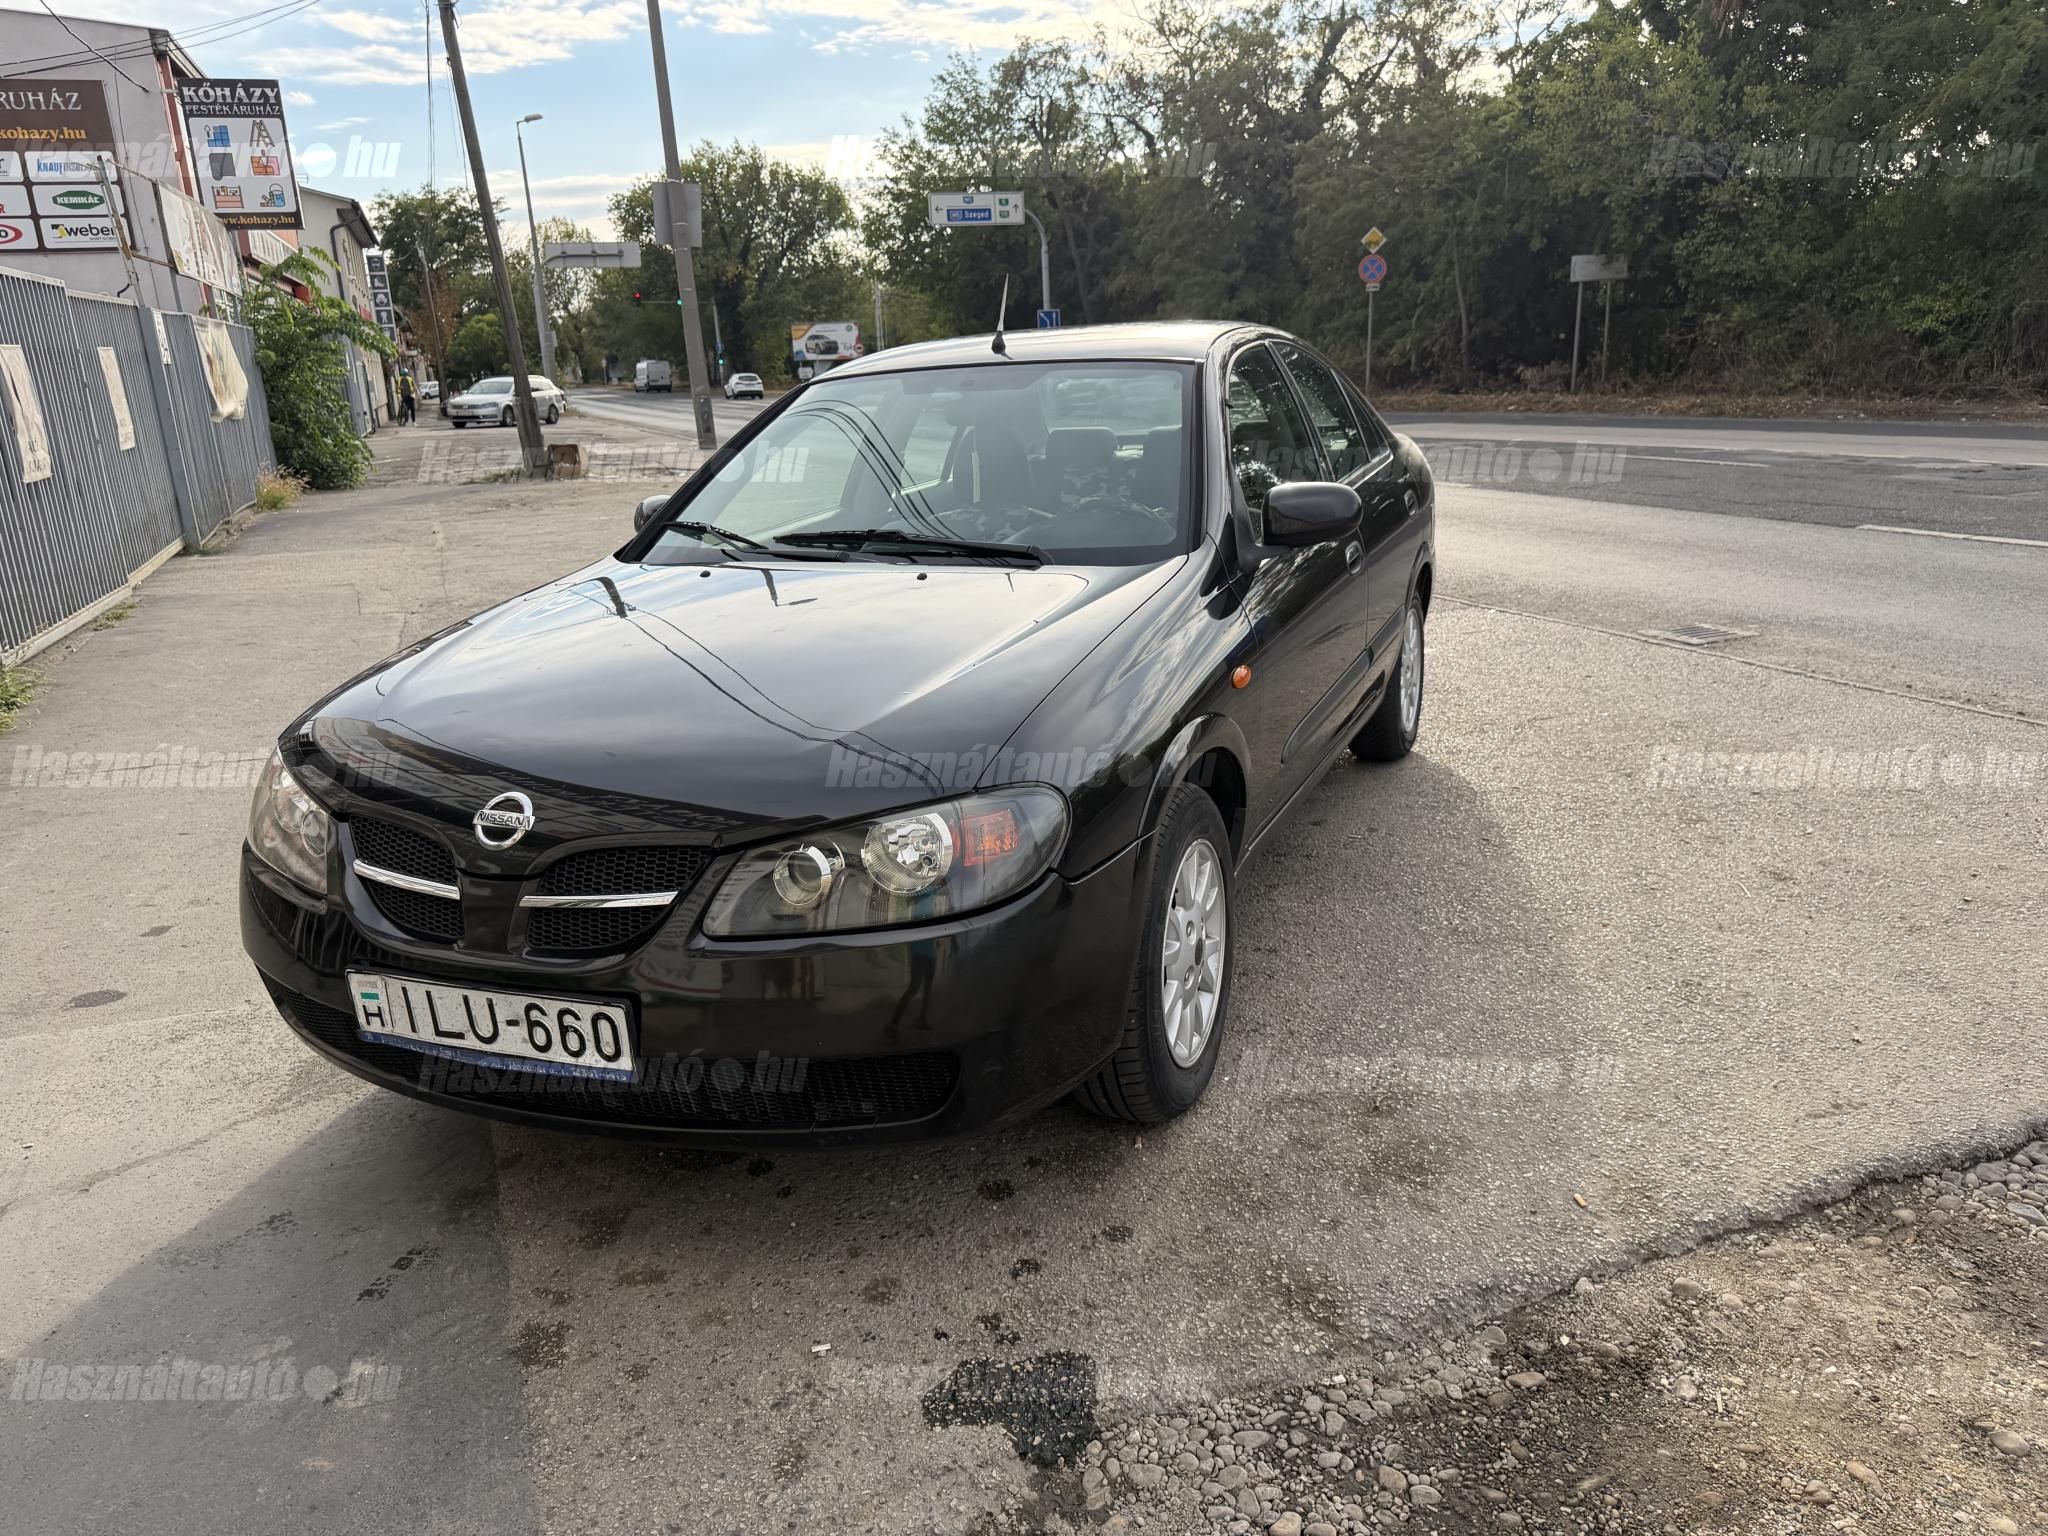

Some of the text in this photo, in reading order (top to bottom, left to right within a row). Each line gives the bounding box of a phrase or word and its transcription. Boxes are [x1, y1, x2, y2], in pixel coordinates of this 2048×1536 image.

[181, 82, 279, 103] KŐHÁZY
[185, 104, 281, 115] FESTÉKÁRUHÁZ
[56, 194, 101, 204] KEMIKÁL
[964, 210, 990, 219] Szeged
[477, 811, 526, 829] NISSAN
[362, 1004, 386, 1028] H
[401, 986, 622, 1063] ILU-660
